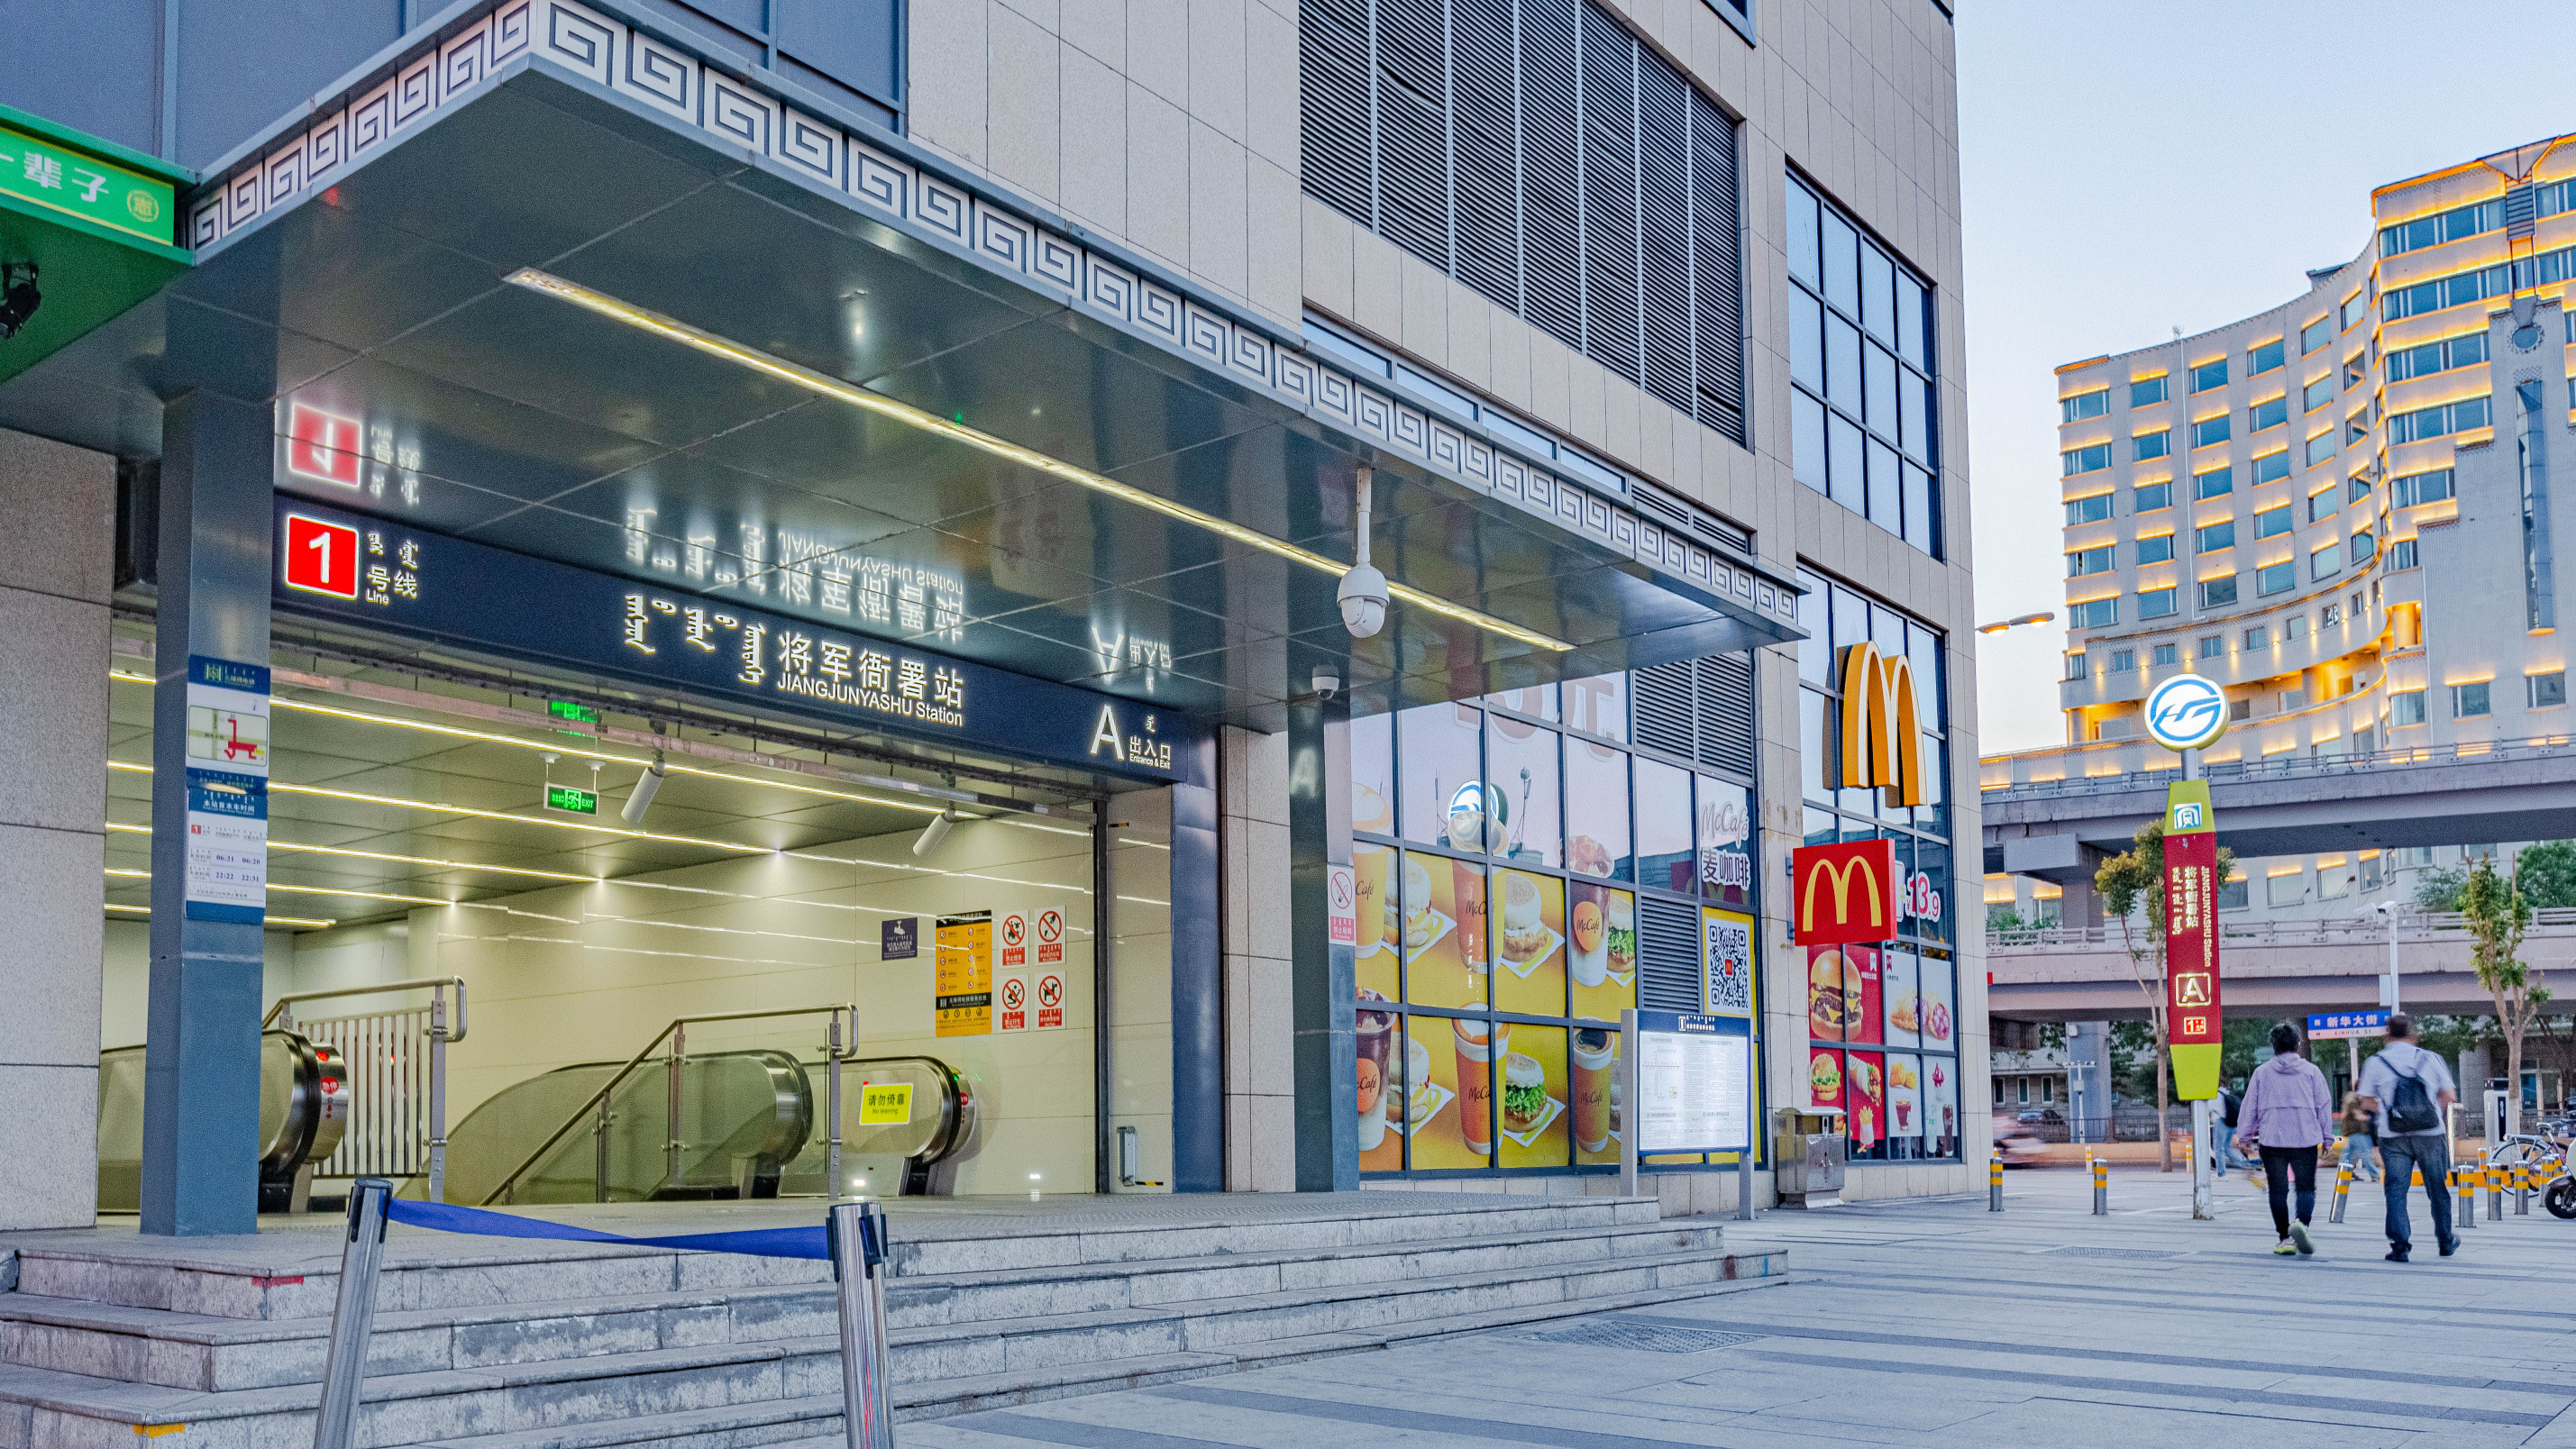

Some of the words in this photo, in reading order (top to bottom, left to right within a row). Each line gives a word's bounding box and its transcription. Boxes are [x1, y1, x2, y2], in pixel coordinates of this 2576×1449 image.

[308, 531, 331, 584] 1
[367, 563, 418, 599] 号线
[366, 588, 389, 606] Line
[778, 631, 964, 708] 将军衙署站
[777, 671, 912, 716] JIANGJUNYASHU
[916, 701, 963, 726] Station
[1090, 704, 1125, 761] A
[1129, 735, 1171, 761] 出入口
[1129, 753, 1154, 766] Entrance
[1159, 758, 1171, 770] Exit
[581, 797, 594, 809] EXIT
[1702, 801, 1748, 845] McCafé
[1703, 848, 1749, 887] 麦咖啡
[2185, 866, 2198, 928] 将军衙署站
[2201, 866, 2212, 938] JIANGJUNYASHU
[1577, 917, 1600, 934] McCafé
[2204, 939, 2213, 967] Station
[2181, 977, 2206, 1002] A
[2188, 1020, 2193, 1032] 1
[2327, 1015, 2378, 1027] 新华大街
[869, 1093, 905, 1107] 请勿倚靠
[1580, 1089, 1603, 1106] McCafé
[880, 1107, 899, 1116] leaning
